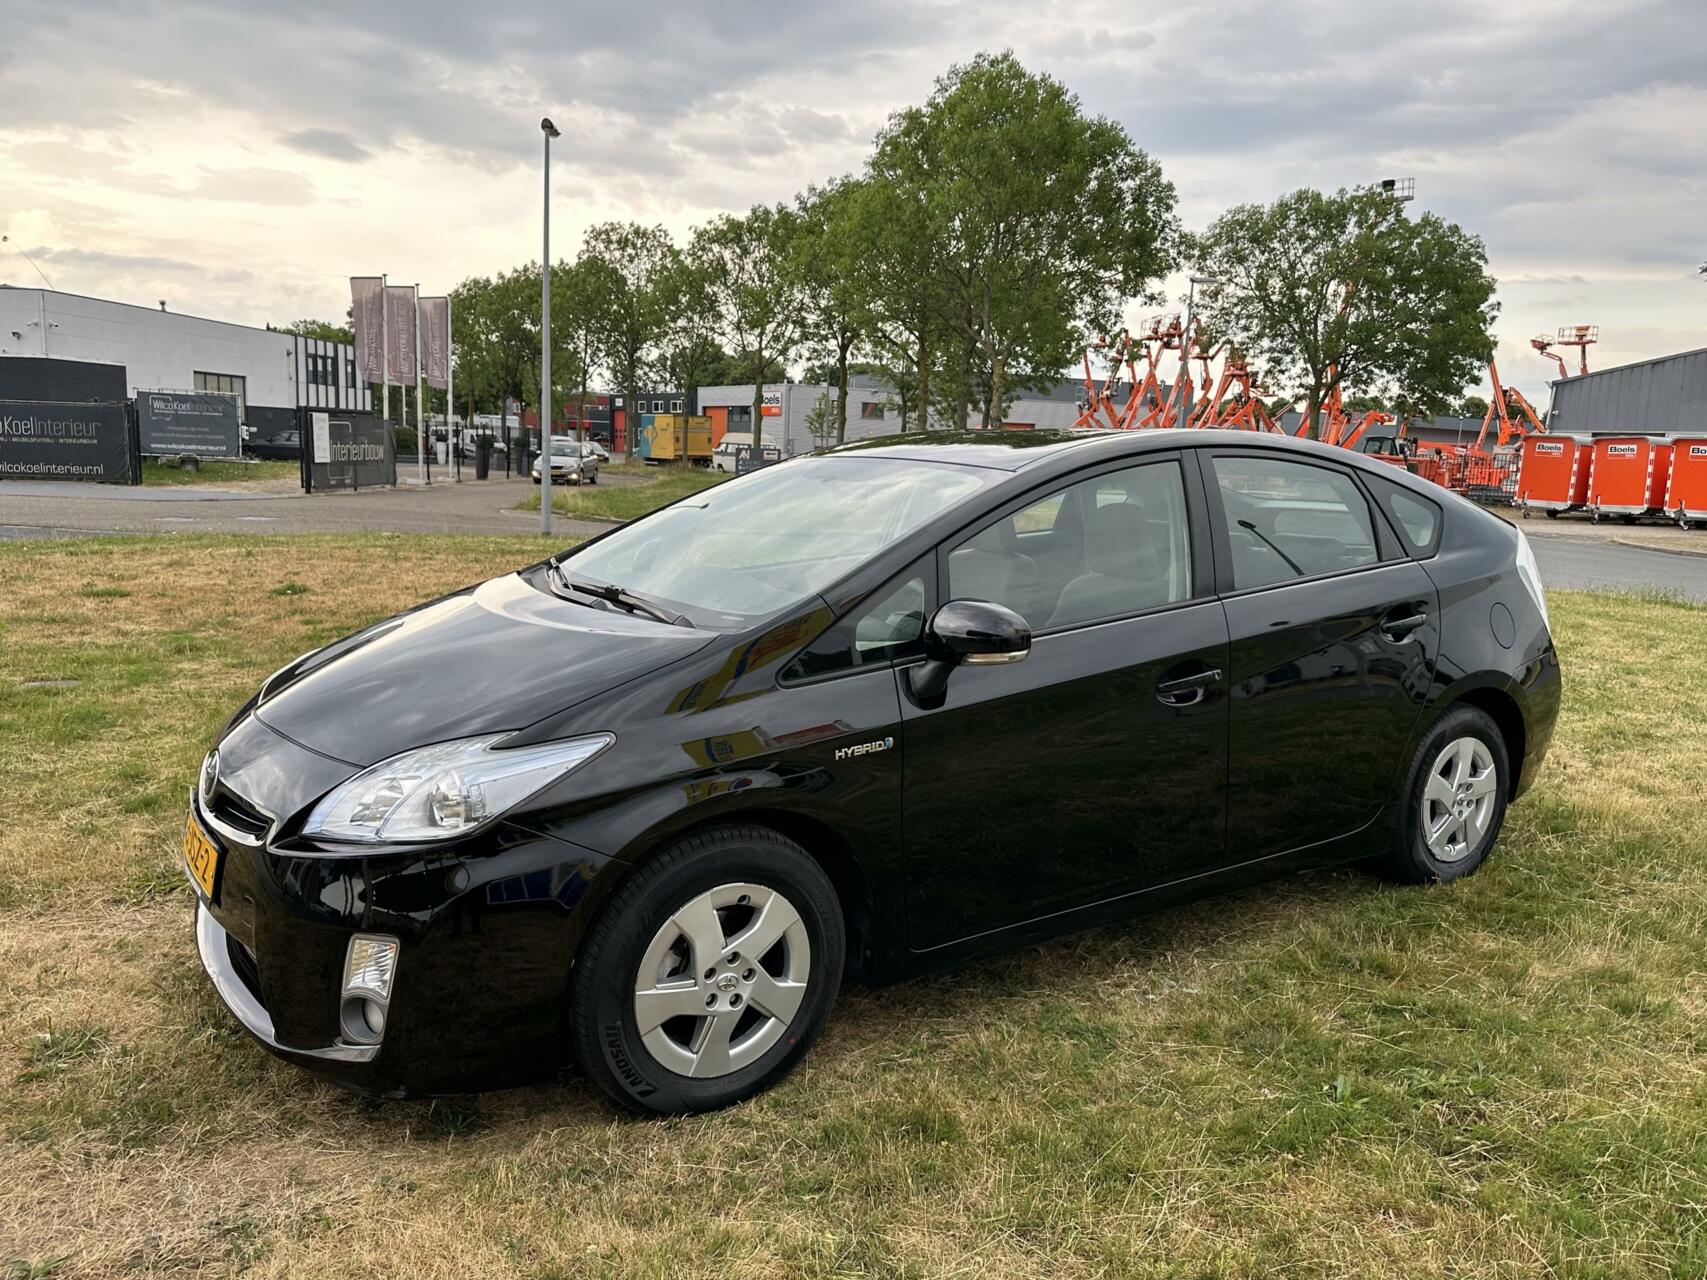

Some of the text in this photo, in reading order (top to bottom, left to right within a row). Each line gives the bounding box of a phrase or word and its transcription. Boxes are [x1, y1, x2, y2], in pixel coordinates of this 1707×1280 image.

[761, 394, 780, 405] oels
[0, 416, 101, 437] KoelInterieur
[1537, 443, 1562, 452] Boels
[1609, 445, 1635, 453] Boels
[835, 740, 885, 761] HYBRID
